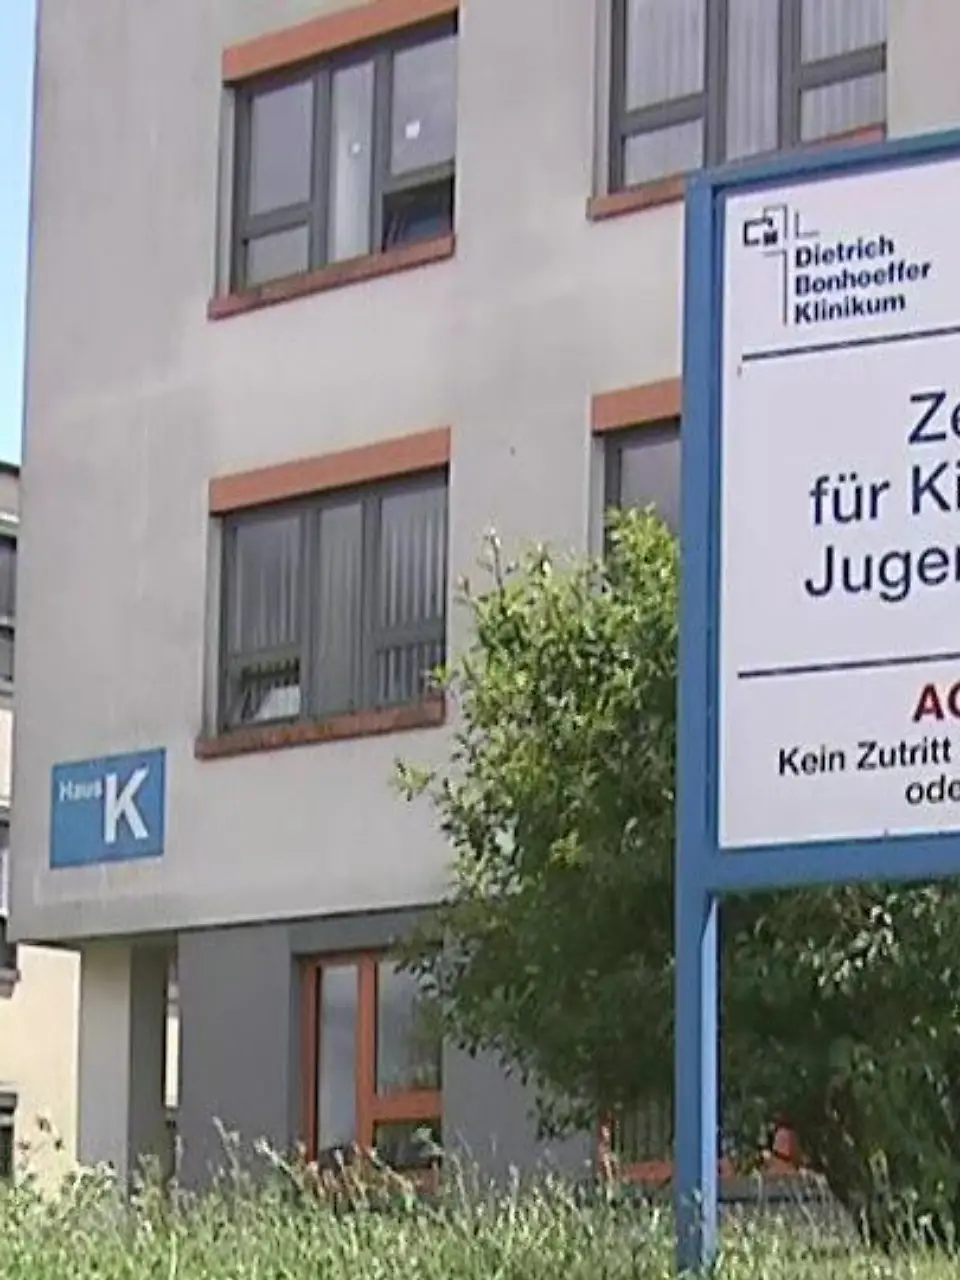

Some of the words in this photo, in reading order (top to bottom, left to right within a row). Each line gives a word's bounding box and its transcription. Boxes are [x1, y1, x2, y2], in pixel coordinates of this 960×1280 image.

[794, 235, 895, 269] Dietrich
[795, 259, 931, 297] Bonhoeffer
[794, 293, 906, 325] Klinikum
[808, 472, 891, 526] für
[778, 745, 846, 777] Kein
[856, 736, 952, 771] Zutritt
[58, 779, 103, 802] Haus
[103, 764, 150, 844] K
